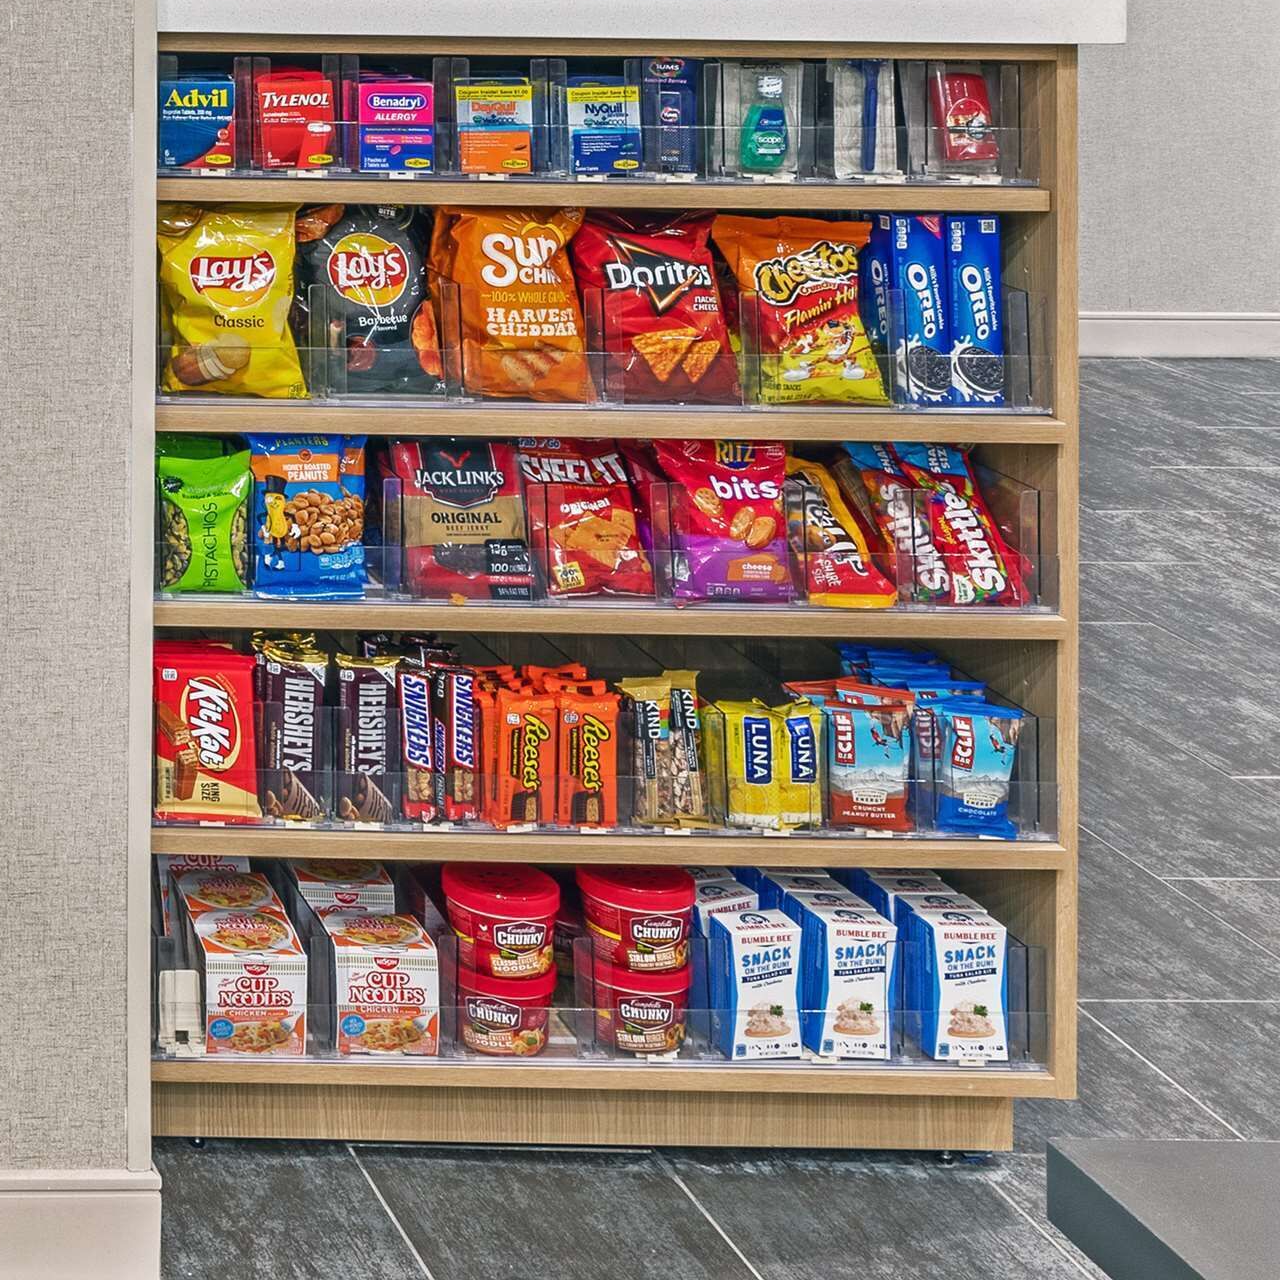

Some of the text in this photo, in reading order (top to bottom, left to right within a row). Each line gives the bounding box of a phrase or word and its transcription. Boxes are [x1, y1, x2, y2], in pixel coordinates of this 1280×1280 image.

[164, 87, 228, 108] Advil
[262, 92, 330, 109] TYLENOL
[372, 96, 421, 110] Benadryl
[471, 101, 516, 114] DayQuil
[584, 102, 623, 116] NyQuil
[374, 113, 418, 121] ALLERGY
[758, 135, 782, 146] scope
[336, 248, 404, 289] Lay's
[480, 232, 558, 288] Sun
[197, 252, 272, 290] Lay's
[606, 261, 713, 291] Doritos
[758, 243, 859, 302] Chetos
[491, 291, 548, 303] 100% WHOLE
[800, 281, 838, 296] Crunchy
[871, 259, 888, 335] OREO
[906, 263, 936, 339] OREO
[961, 265, 990, 340] OREO
[213, 314, 265, 328] Classic
[358, 313, 408, 327] Barbecue
[486, 307, 575, 323] HARVEST
[783, 298, 833, 333] Flamin'
[486, 322, 577, 337] CHEDDAR
[714, 439, 756, 464] RITZ
[287, 471, 329, 481] PEANUTS
[415, 469, 456, 492] JACK
[710, 476, 780, 501] bits
[431, 512, 502, 524] ORIGINAL
[202, 502, 219, 587] PISTACHIOS
[942, 480, 1007, 592] Skittles
[490, 563, 508, 572] 100
[742, 562, 773, 571] cheese
[681, 688, 697, 730] KIND
[282, 677, 315, 772] HERSHEY'S
[402, 675, 432, 769] SNICKERS
[453, 674, 474, 767] SNICKERS
[644, 700, 661, 739] KIND
[357, 683, 387, 776] HERSHEY'S
[836, 714, 854, 753] CLIF
[953, 718, 973, 756] CLIF
[522, 712, 551, 792] Reese's
[582, 713, 610, 792] Reese's
[750, 723, 769, 779] LUNA
[792, 723, 813, 779] LUNA
[200, 782, 211, 802] SIZE
[210, 782, 220, 802] KING
[855, 796, 885, 805] ENERGY
[966, 799, 995, 808] ENERGY
[735, 902, 752, 911] BEE
[497, 931, 544, 946] CHUNKY
[633, 924, 680, 939] CHUNKY
[741, 936, 775, 944] BUMBLE
[836, 929, 888, 939] BUMBLE BEE
[944, 932, 997, 940] BUMBLE BEE
[741, 946, 791, 967] SNACK
[835, 944, 887, 960] SNACK
[944, 945, 996, 963] SNACK
[493, 963, 539, 972] NOODLE
[745, 965, 771, 975] ON THE
[837, 959, 862, 968] ON THE
[948, 962, 973, 971] ON THE
[235, 977, 279, 993] CUP
[366, 971, 410, 988] CUP
[217, 991, 293, 1008] NOODLES
[348, 986, 425, 1005] NOODLES
[360, 1006, 399, 1014] CHICKEN
[468, 1003, 518, 1026] CHUNKY
[620, 1004, 670, 1021] CHUNKY
